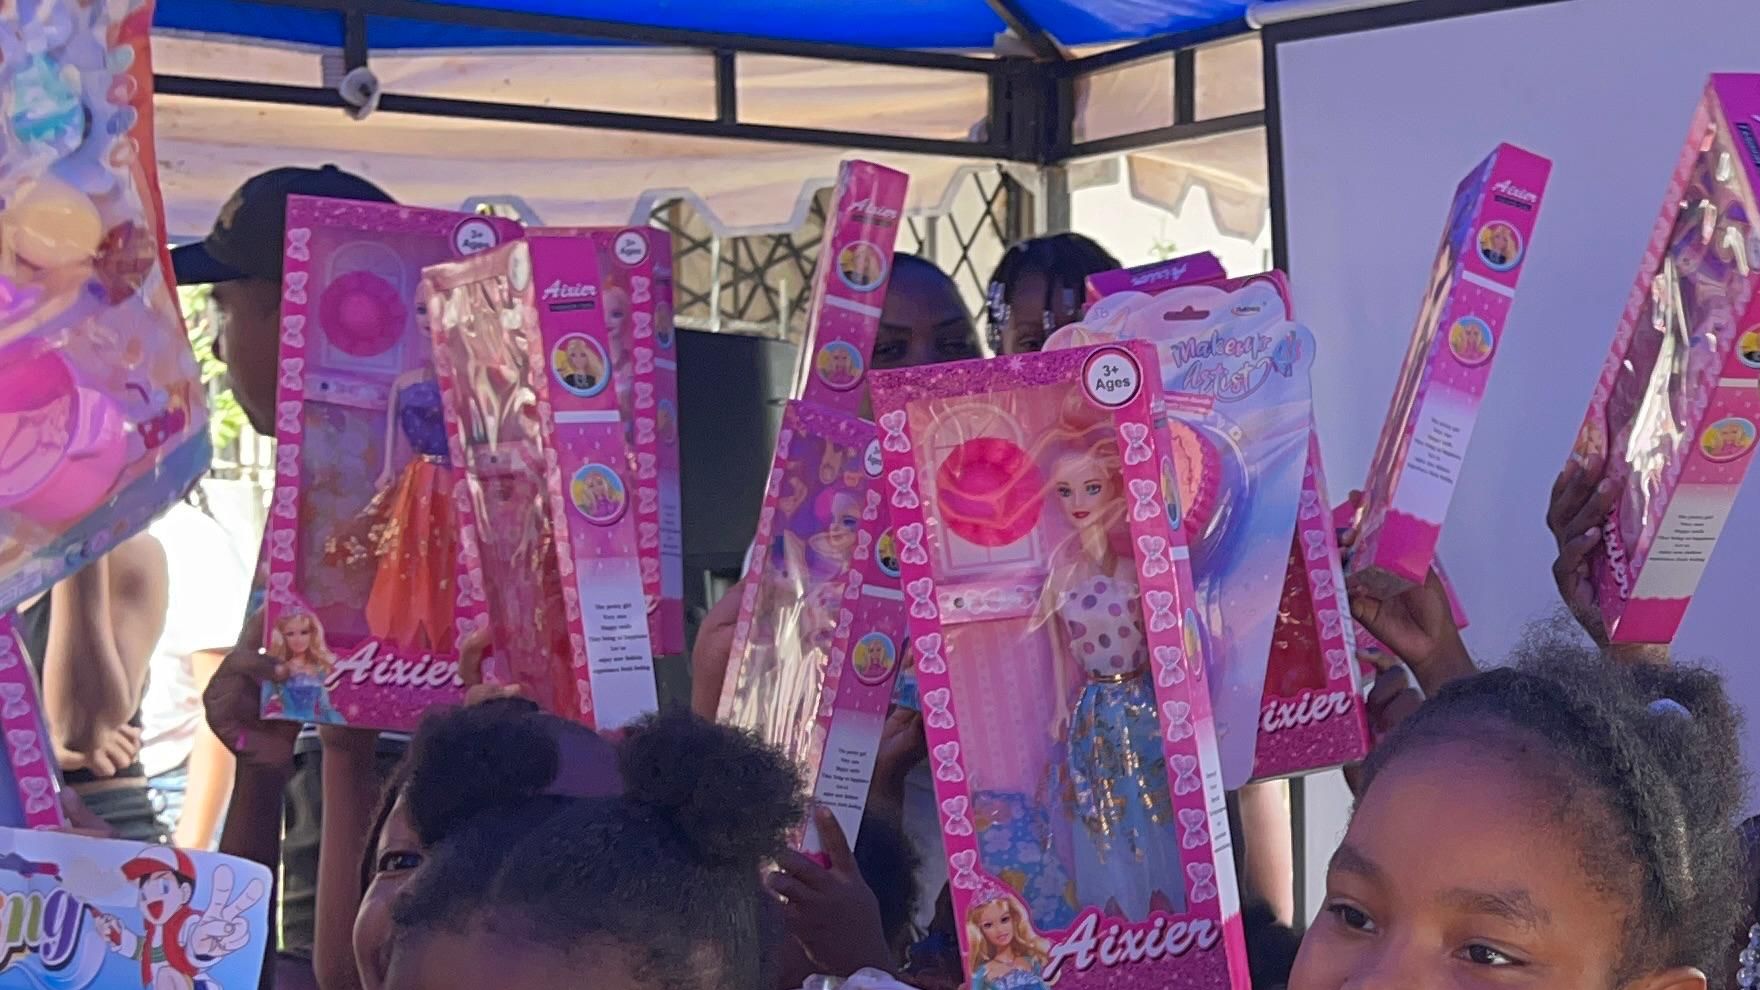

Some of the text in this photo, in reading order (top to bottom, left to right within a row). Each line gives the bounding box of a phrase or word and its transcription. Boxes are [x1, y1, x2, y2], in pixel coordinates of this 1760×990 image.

[1095, 377, 1131, 392] Ages
[1102, 364, 1120, 377] 3+
[1261, 691, 1353, 734] ixier
[1043, 912, 1223, 979] Aixier
